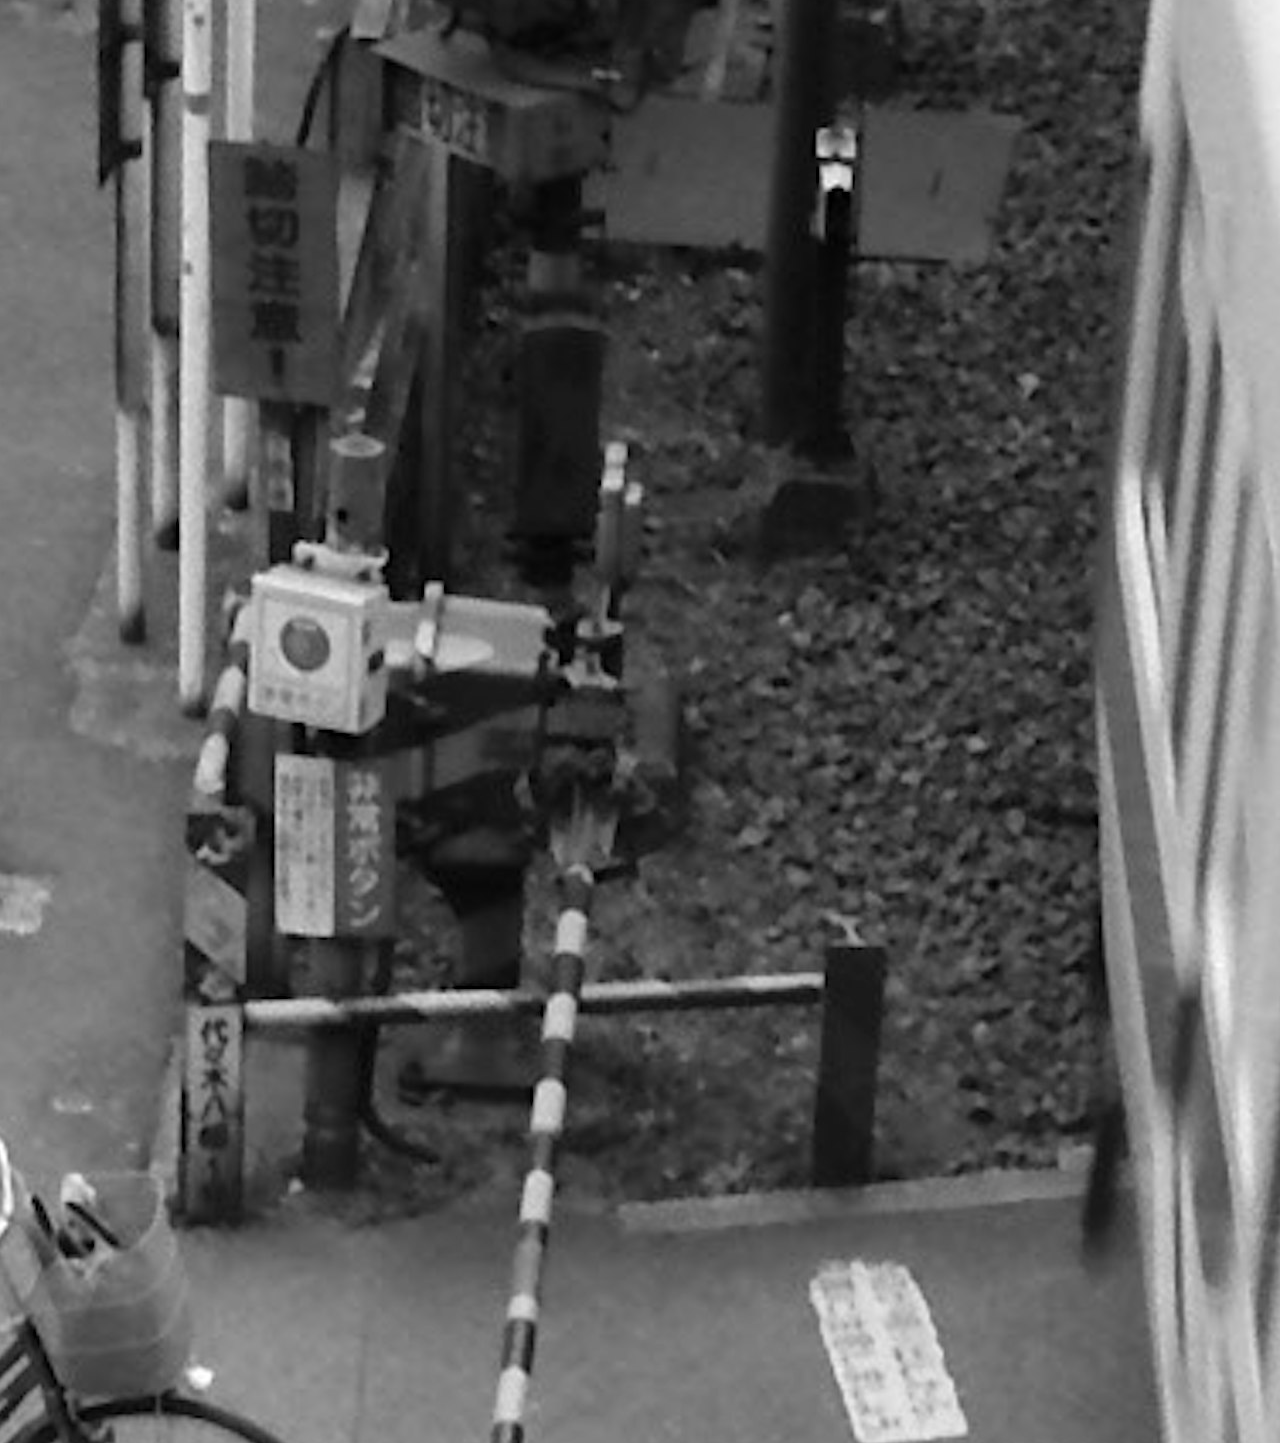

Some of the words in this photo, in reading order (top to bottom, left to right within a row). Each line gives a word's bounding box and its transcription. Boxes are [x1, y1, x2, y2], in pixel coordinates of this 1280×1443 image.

[346, 770, 382, 928] 非常ボタン
